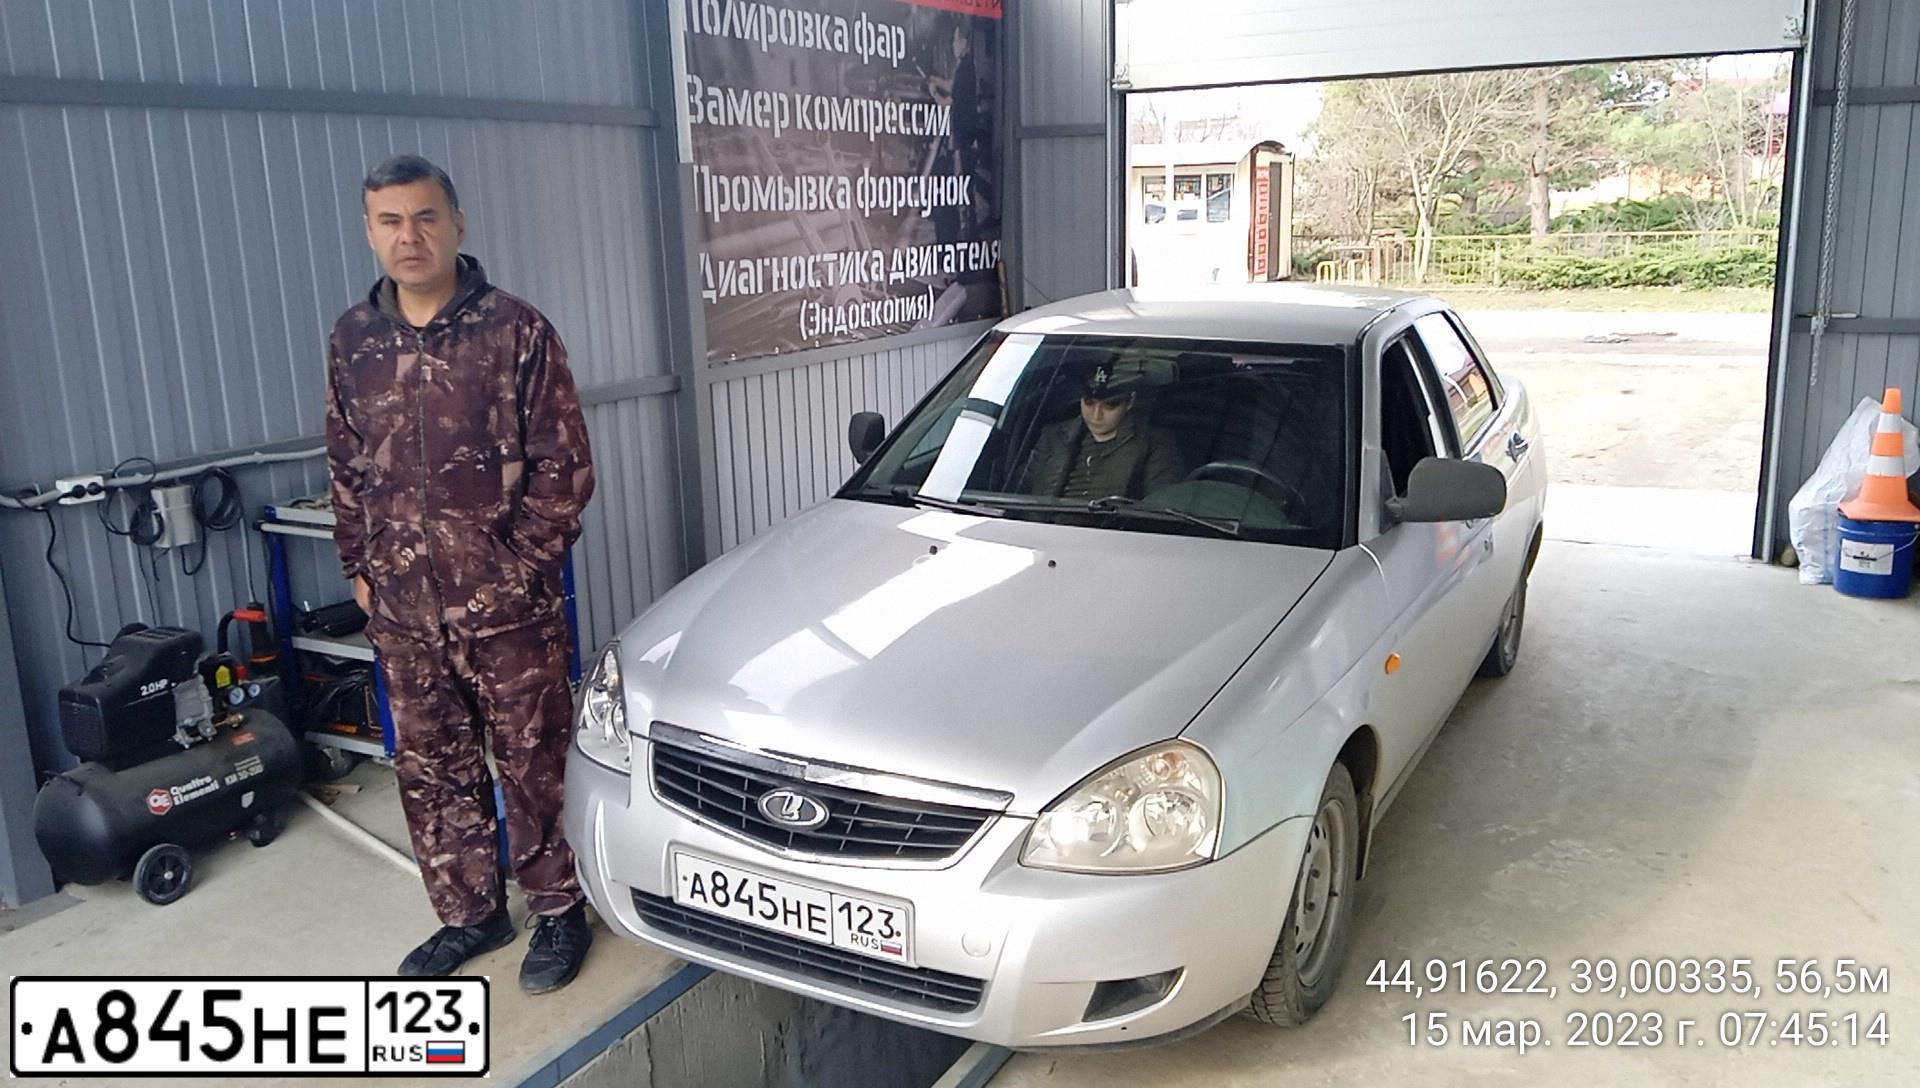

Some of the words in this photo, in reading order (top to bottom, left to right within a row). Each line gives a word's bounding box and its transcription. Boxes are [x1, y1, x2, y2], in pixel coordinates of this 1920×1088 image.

[854, 11, 906, 68] фар
[687, 73, 790, 138] Замер
[795, 92, 951, 142] компрессии
[693, 165, 851, 223] Промывка
[856, 167, 971, 217] форсунок
[700, 249, 884, 304] Диагностика
[889, 240, 1000, 285] двигателя
[800, 285, 936, 341] (Эндоскопия)
[1094, 366, 1108, 383] LA
[690, 871, 827, 936] А845НЕ
[838, 901, 895, 939] 123
[850, 932, 880, 950] RUS
